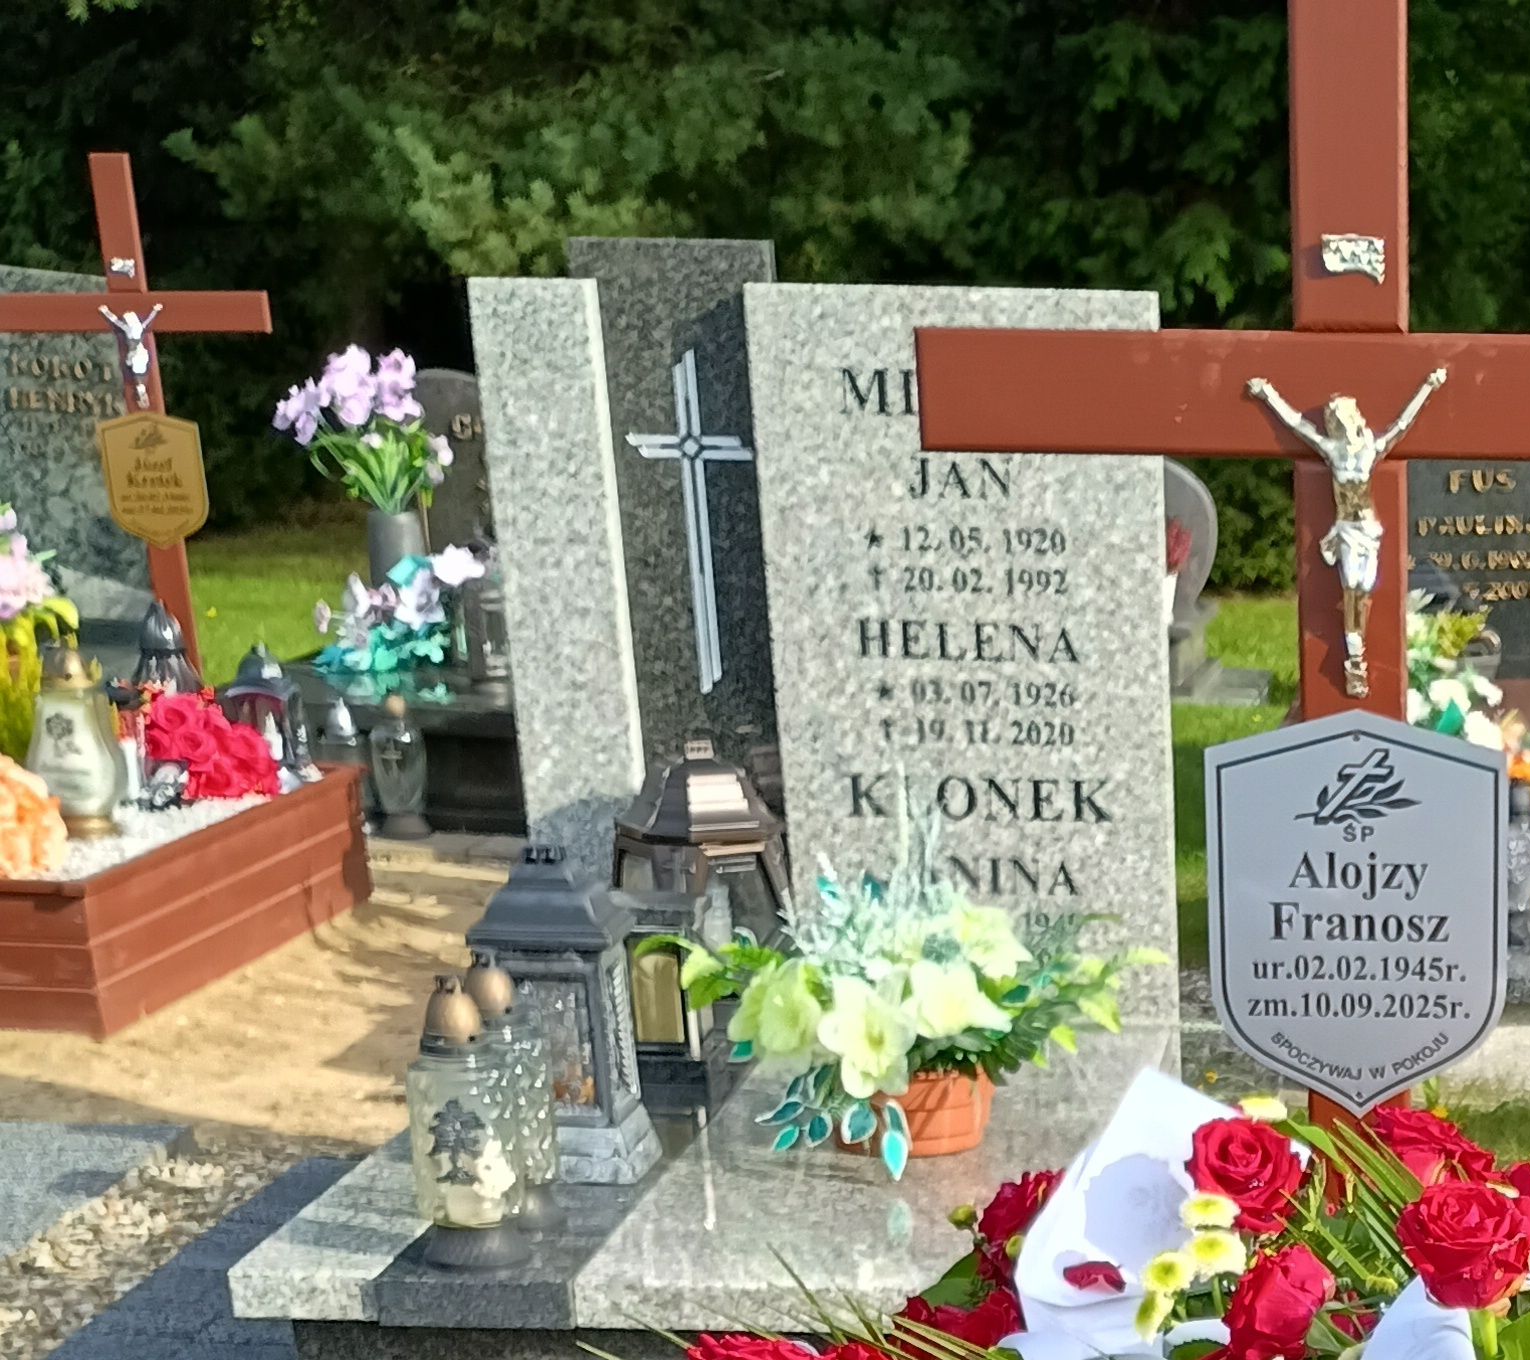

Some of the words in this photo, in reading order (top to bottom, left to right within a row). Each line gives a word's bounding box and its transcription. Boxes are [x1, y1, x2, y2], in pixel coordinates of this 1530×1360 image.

[907, 457, 1011, 499] JAN
[1447, 468, 1518, 494] FUS
[857, 617, 1081, 665] HELENA
[1342, 823, 1375, 843] ŚP
[930, 854, 1079, 897] NINA
[1288, 851, 1428, 900] Alojzy
[1269, 901, 1451, 943] Franosz
[1252, 955, 1467, 983] ur.02.02.1945r.
[1247, 993, 1471, 1019] zm.10.09.2025r.
[1271, 1031, 1363, 1081] SPOCZYWAJ
[1368, 1065, 1388, 1082] W
[1392, 1031, 1451, 1077] POKOJU
